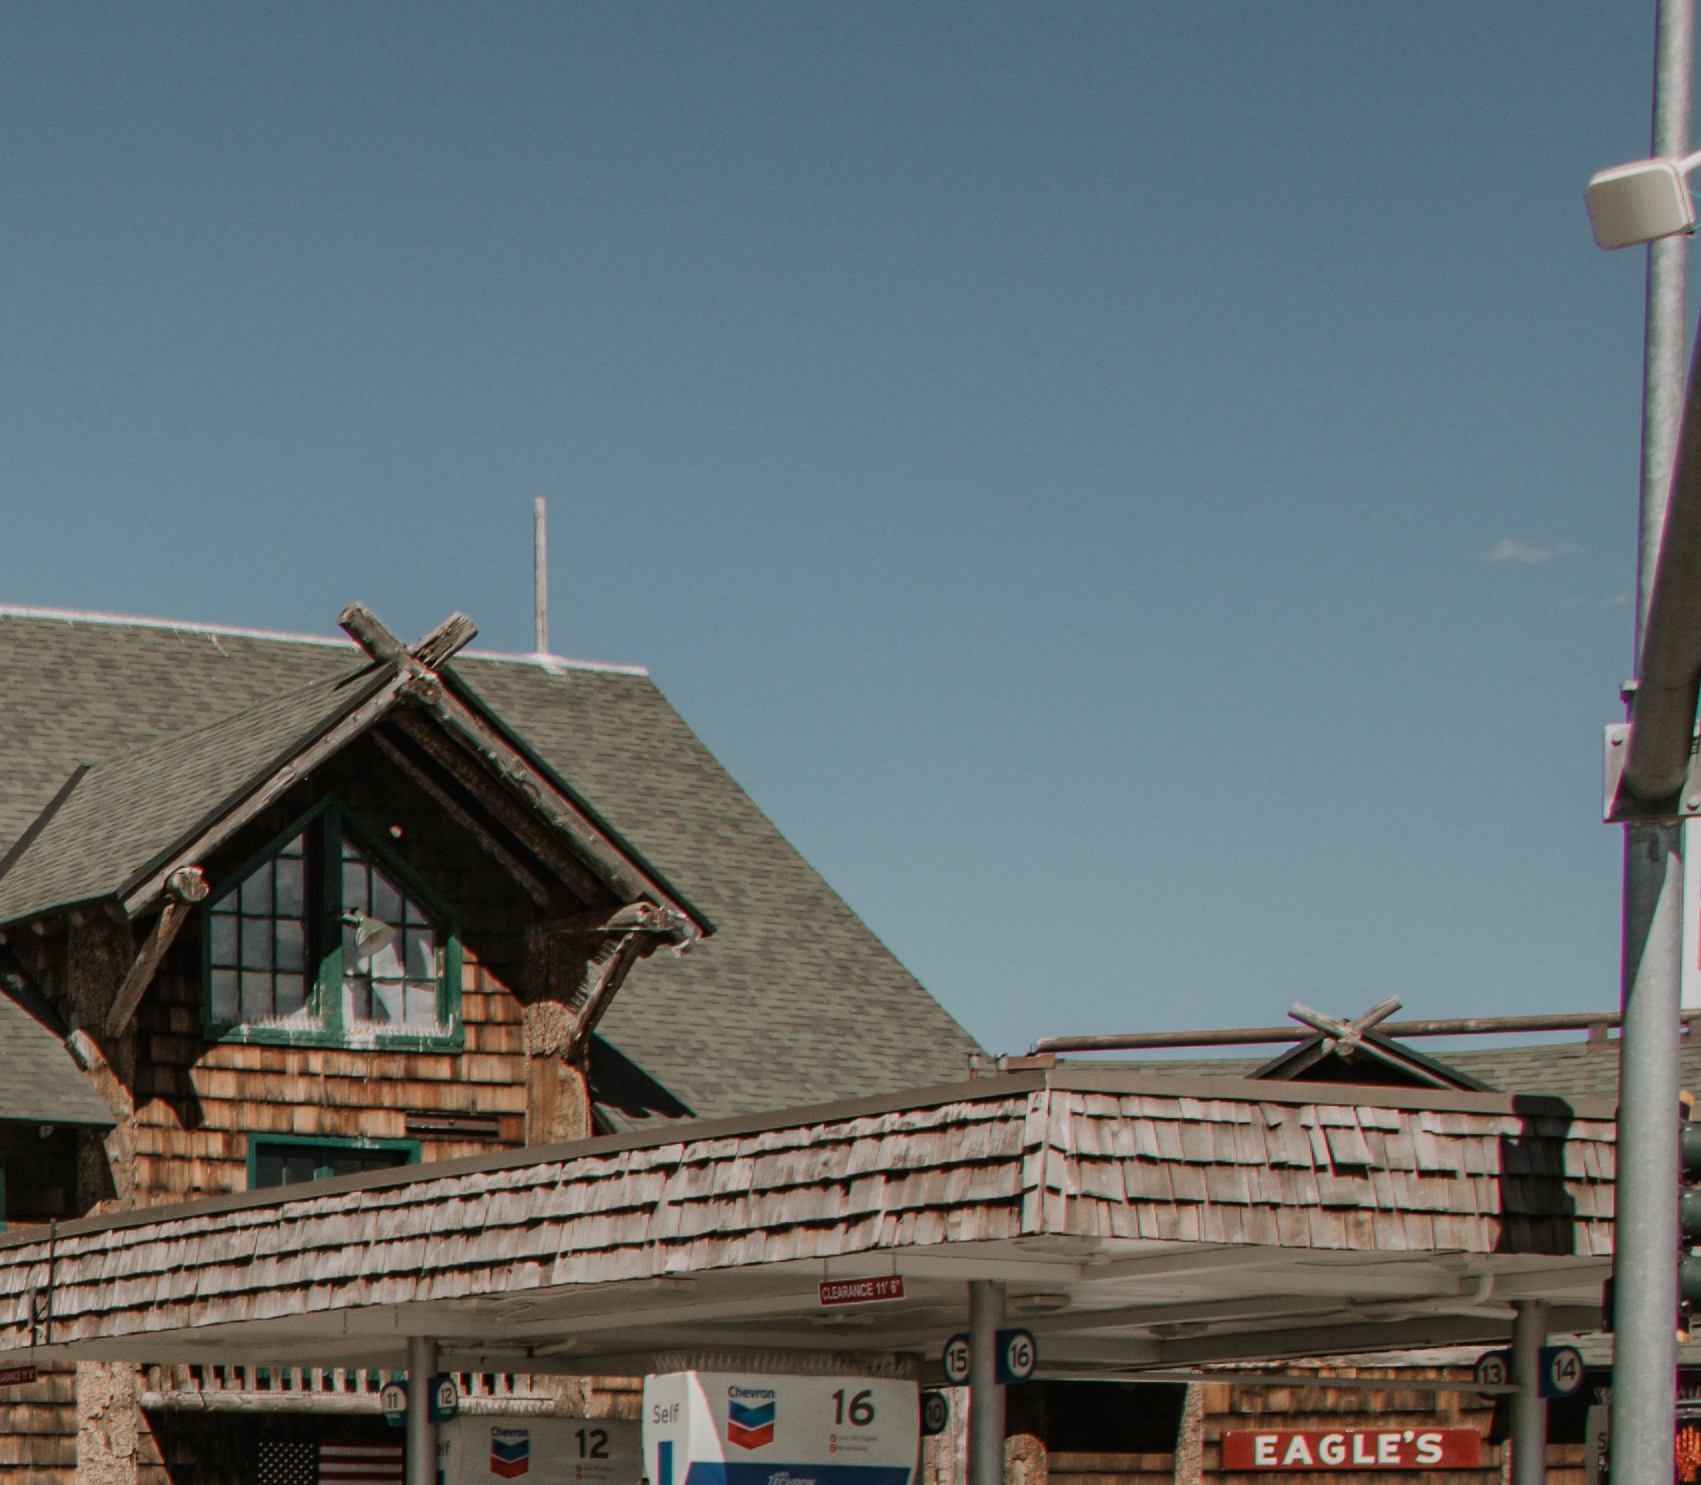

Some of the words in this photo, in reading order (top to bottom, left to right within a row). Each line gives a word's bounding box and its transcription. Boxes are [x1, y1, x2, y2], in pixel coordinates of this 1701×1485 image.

[822, 1282, 874, 1300] CLEARANCE
[949, 1349, 967, 1373] 15
[1011, 1344, 1029, 1369] 16
[1480, 1364, 1500, 1385] 13
[1554, 1358, 1576, 1381] 14
[387, 1393, 398, 1408] 11
[440, 1387, 454, 1404] 12
[727, 1386, 775, 1399] Chevron
[652, 1403, 680, 1424] Self
[831, 1389, 876, 1427] 16
[490, 1426, 529, 1438] Chevron
[574, 1428, 609, 1459] 12
[1254, 1431, 1444, 1466] EAGLE'S
